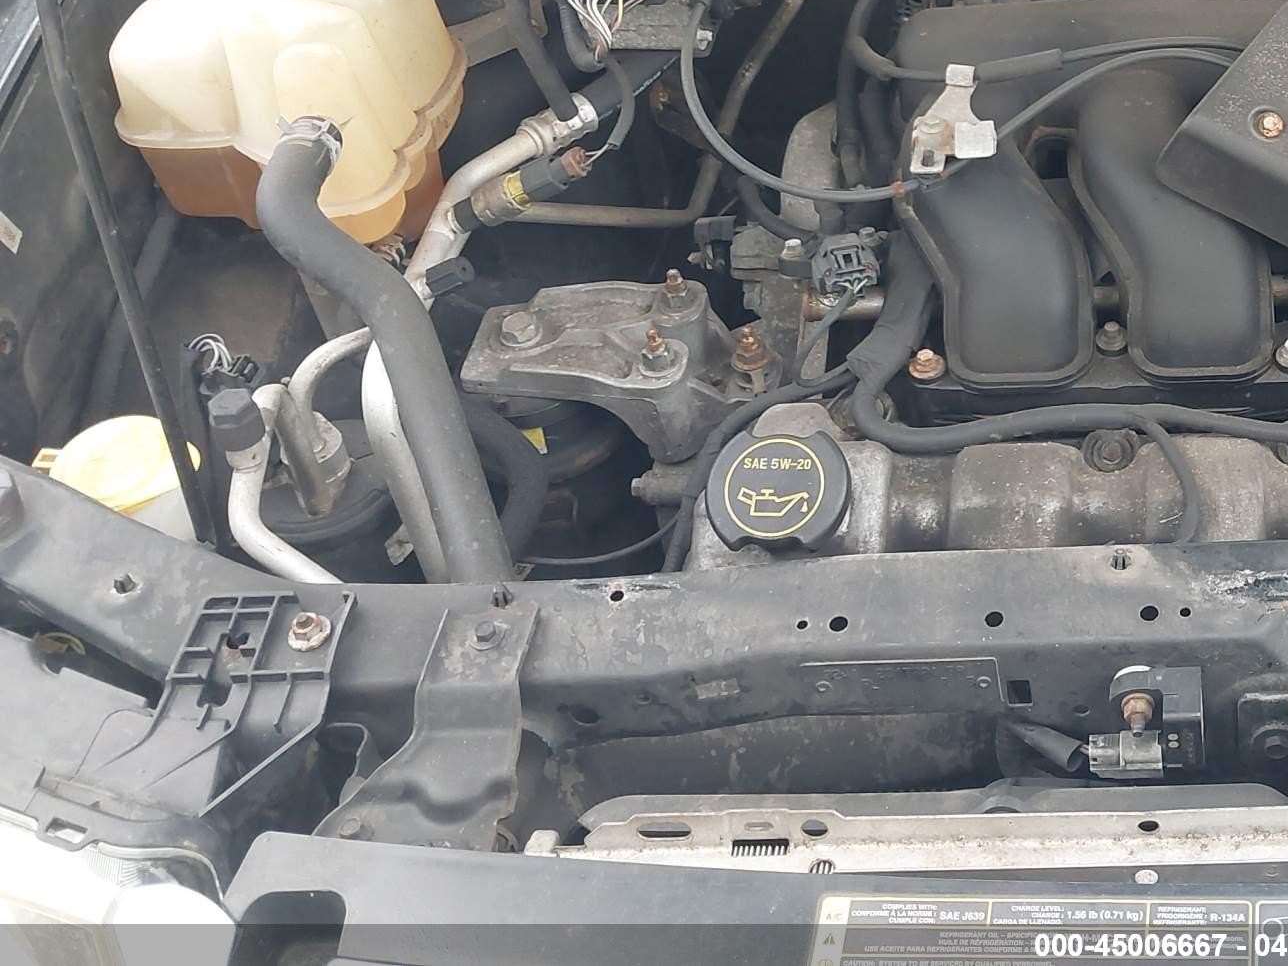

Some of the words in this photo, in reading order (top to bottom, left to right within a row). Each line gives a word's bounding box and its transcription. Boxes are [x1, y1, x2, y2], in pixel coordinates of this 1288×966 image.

[743, 457, 768, 469] SAE
[770, 458, 812, 470] 5W-20
[940, 911, 961, 921] SAE
[962, 911, 986, 922] J639
[1126, 910, 1144, 922] kg)
[1209, 913, 1246, 922] R-134A
